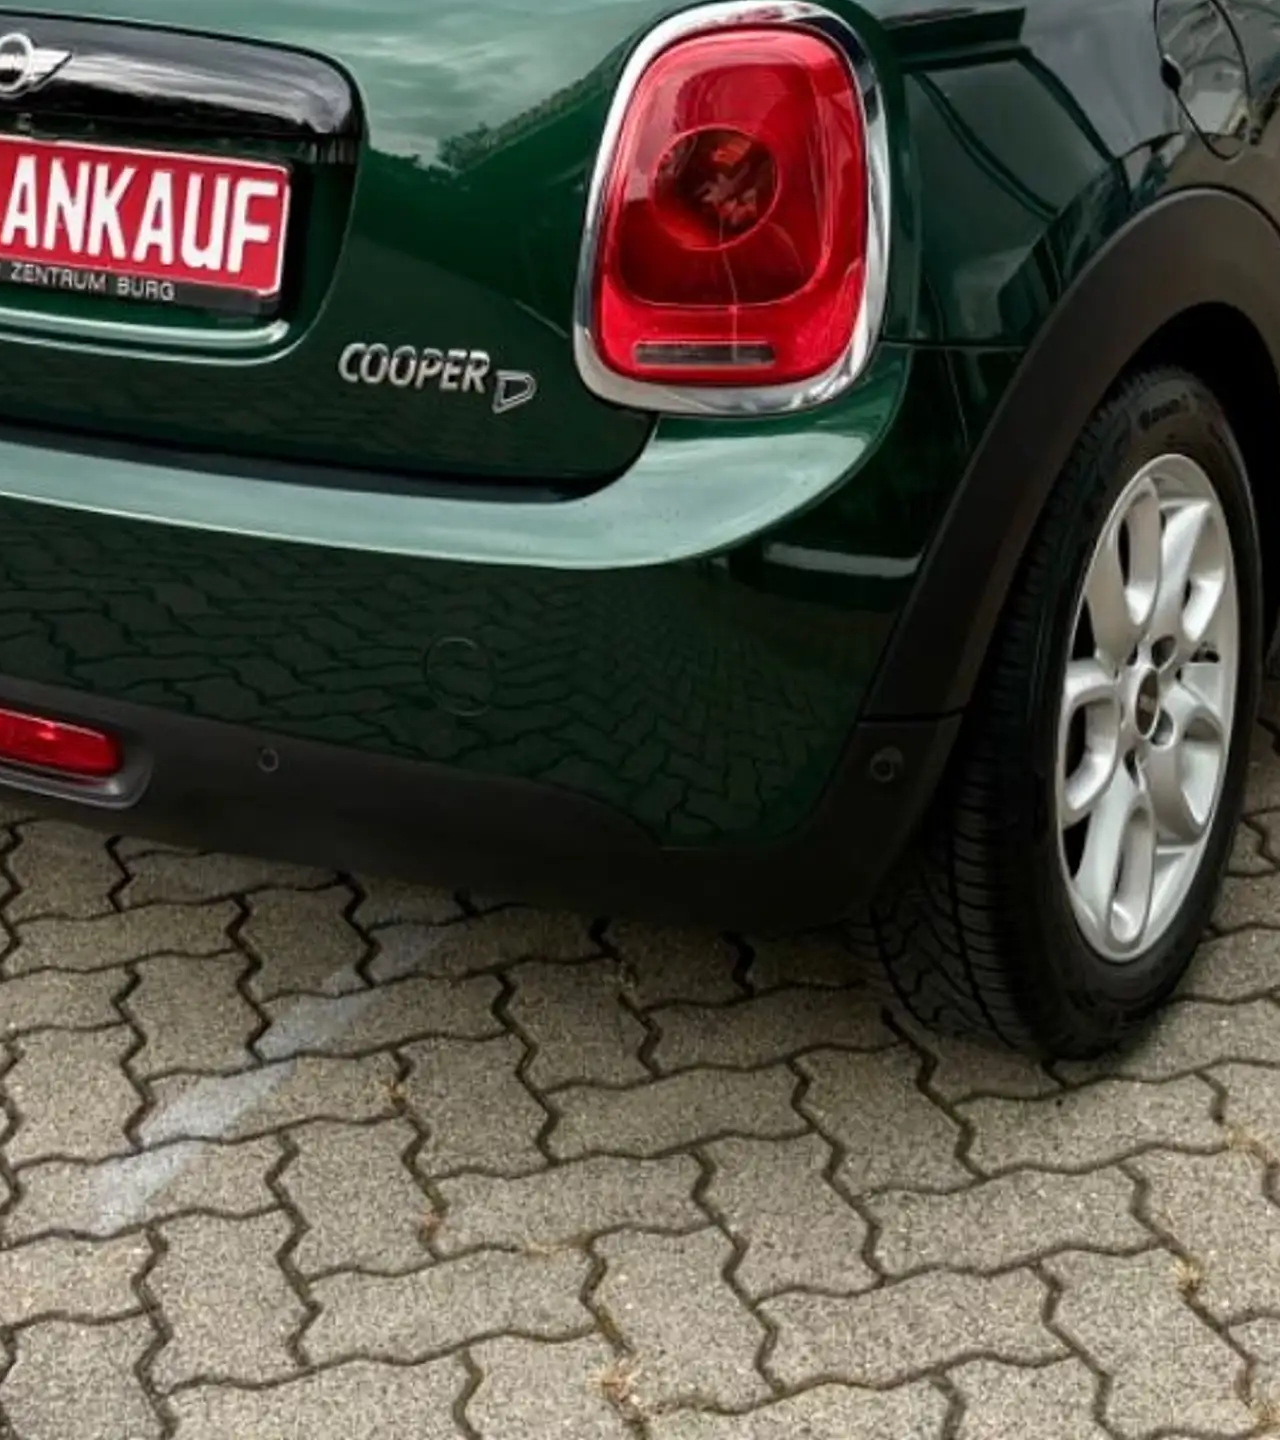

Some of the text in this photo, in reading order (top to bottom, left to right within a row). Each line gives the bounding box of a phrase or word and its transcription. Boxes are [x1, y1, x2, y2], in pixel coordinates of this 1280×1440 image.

[0, 153, 279, 274] ANKAUF
[10, 262, 107, 292] ZENTRUM
[116, 276, 175, 302] BURG
[338, 342, 538, 414] COOPER D
